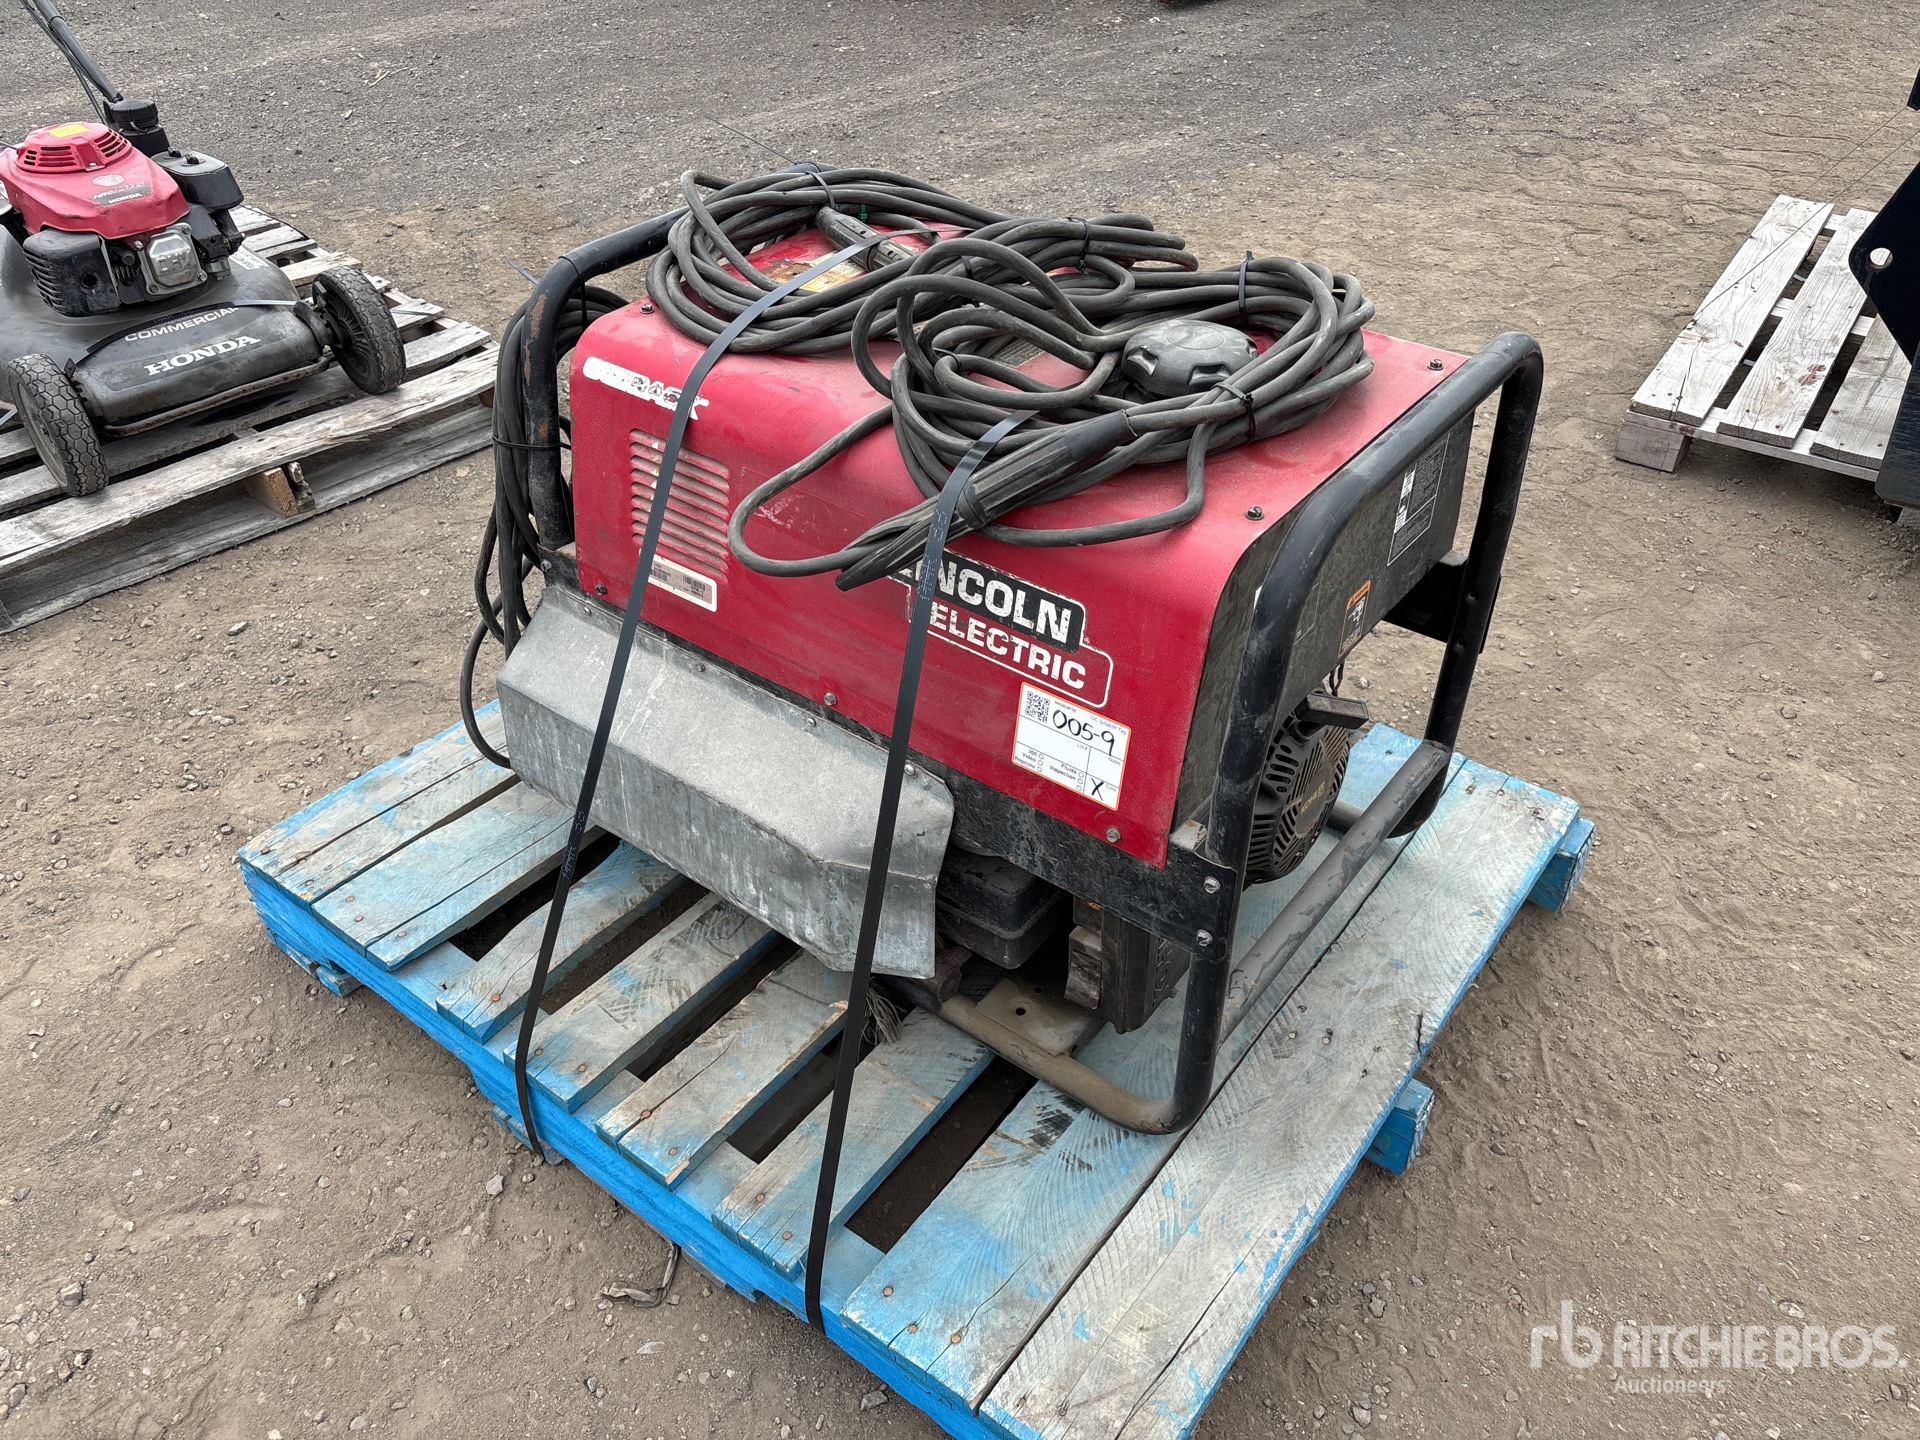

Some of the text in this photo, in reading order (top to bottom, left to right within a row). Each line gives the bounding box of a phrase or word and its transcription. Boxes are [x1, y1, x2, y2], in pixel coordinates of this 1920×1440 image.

[107, 193, 144, 204] HONDA
[143, 335, 262, 376] HONDA
[929, 602, 1087, 690] ELECTRIC
[1053, 709, 1115, 756] 005-9
[1014, 756, 1036, 769] Rephoto
[1022, 752, 1037, 763] Video
[1108, 756, 1121, 766] Notes
[1049, 765, 1077, 781] Inspection
[1060, 763, 1077, 775] Fluids
[1090, 777, 1104, 801] X
